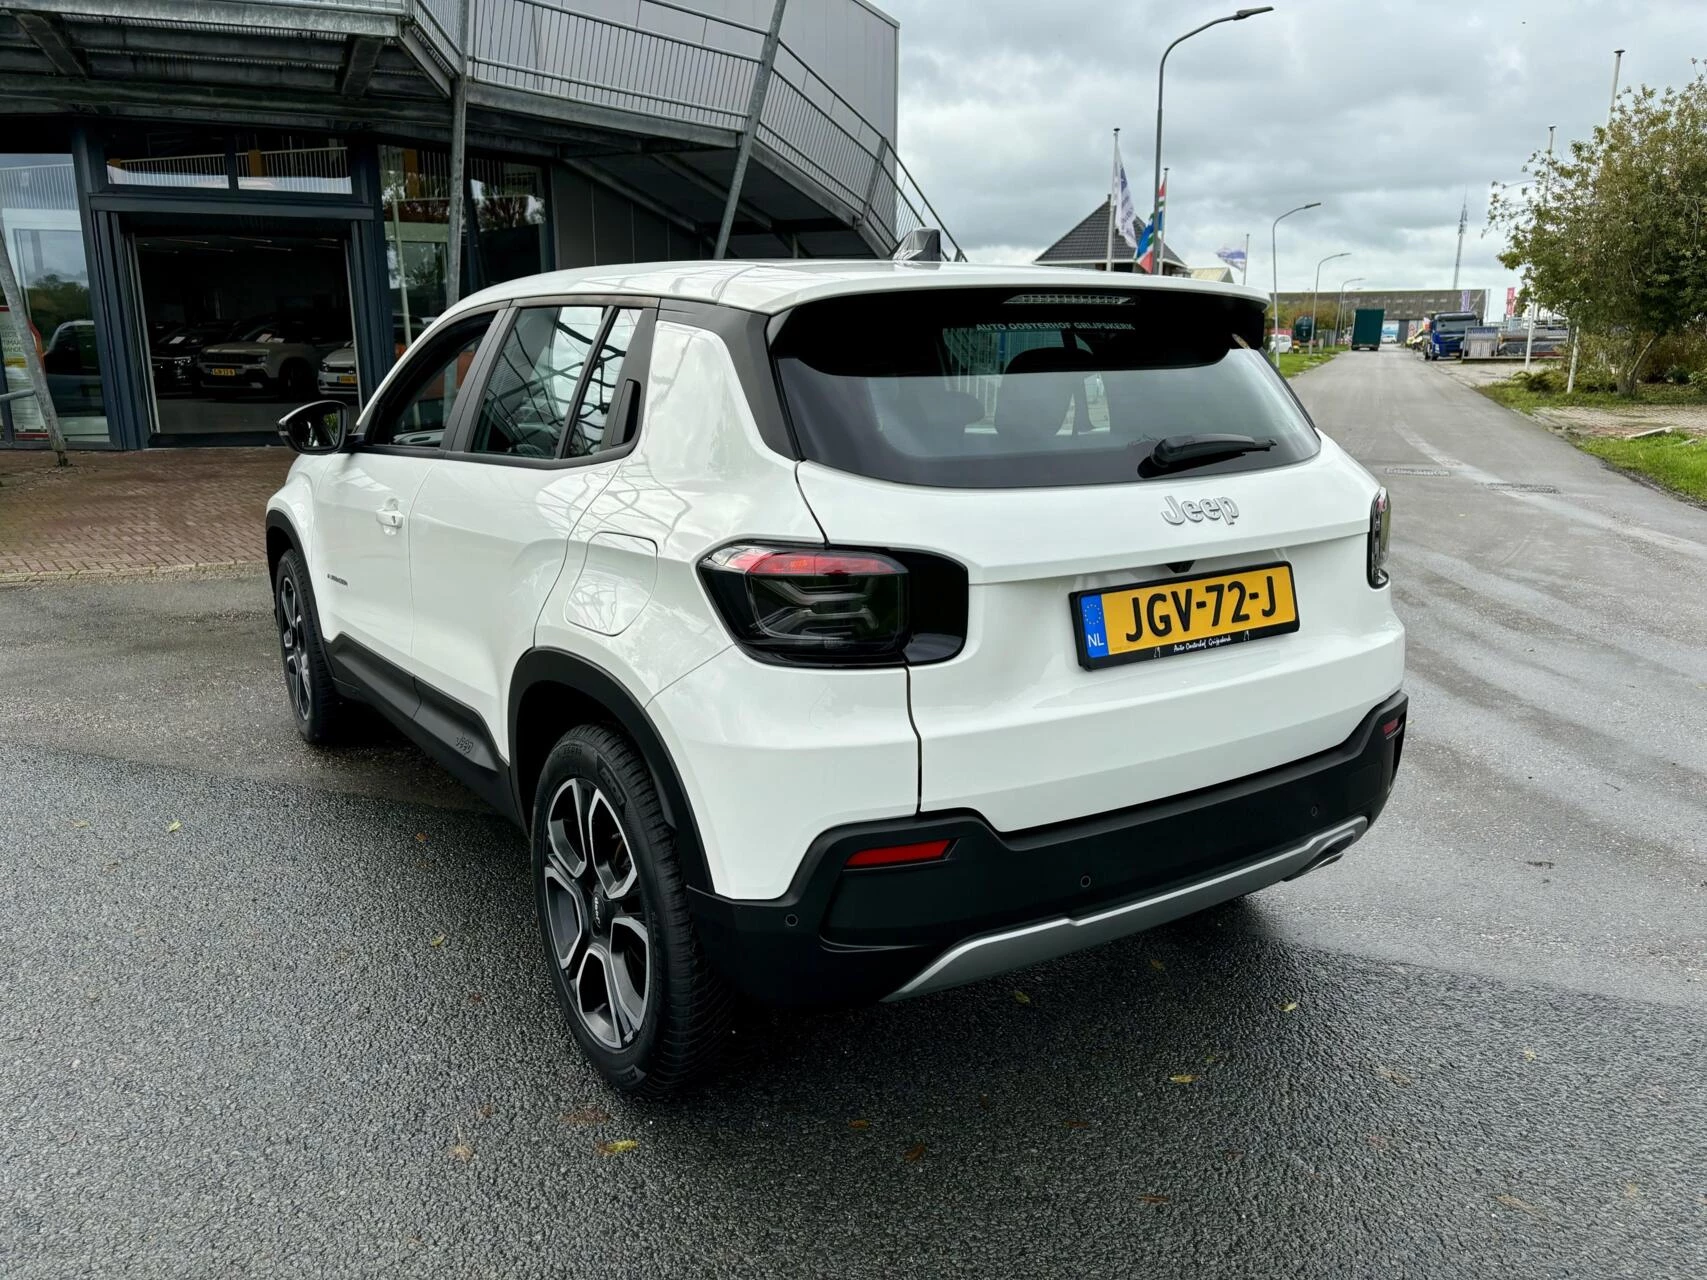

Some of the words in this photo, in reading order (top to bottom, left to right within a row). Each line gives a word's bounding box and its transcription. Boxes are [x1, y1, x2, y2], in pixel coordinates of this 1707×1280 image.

[976, 323, 1006, 331] AUTO
[1008, 322, 1071, 331] OOSTERHOF
[1161, 495, 1239, 526] Jeep
[1126, 575, 1277, 643] JGV-72-J
[1087, 633, 1105, 648] NL
